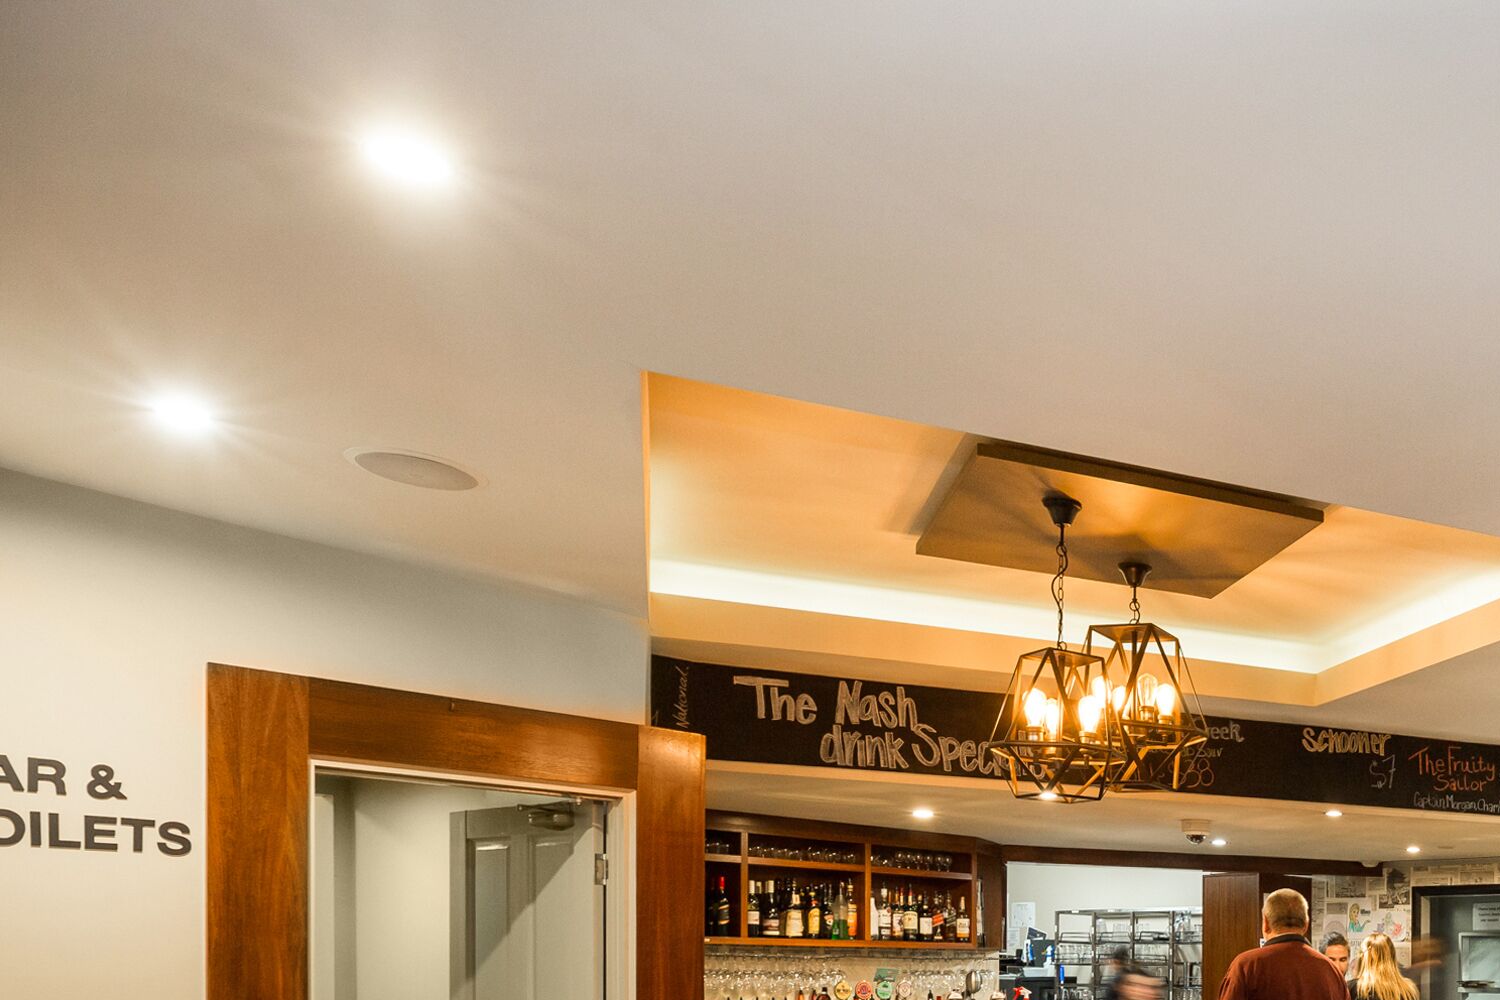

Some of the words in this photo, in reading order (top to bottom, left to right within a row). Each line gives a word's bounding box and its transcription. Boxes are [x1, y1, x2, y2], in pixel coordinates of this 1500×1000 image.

[733, 675, 817, 725] The
[835, 680, 918, 731] Nash
[820, 724, 909, 769] drink
[1301, 727, 1392, 756] Schooner
[1369, 754, 1396, 789] $7
[1407, 746, 1446, 776] The
[1447, 746, 1496, 781] Fruity
[87, 764, 128, 800] &
[1433, 774, 1487, 792] Sailor
